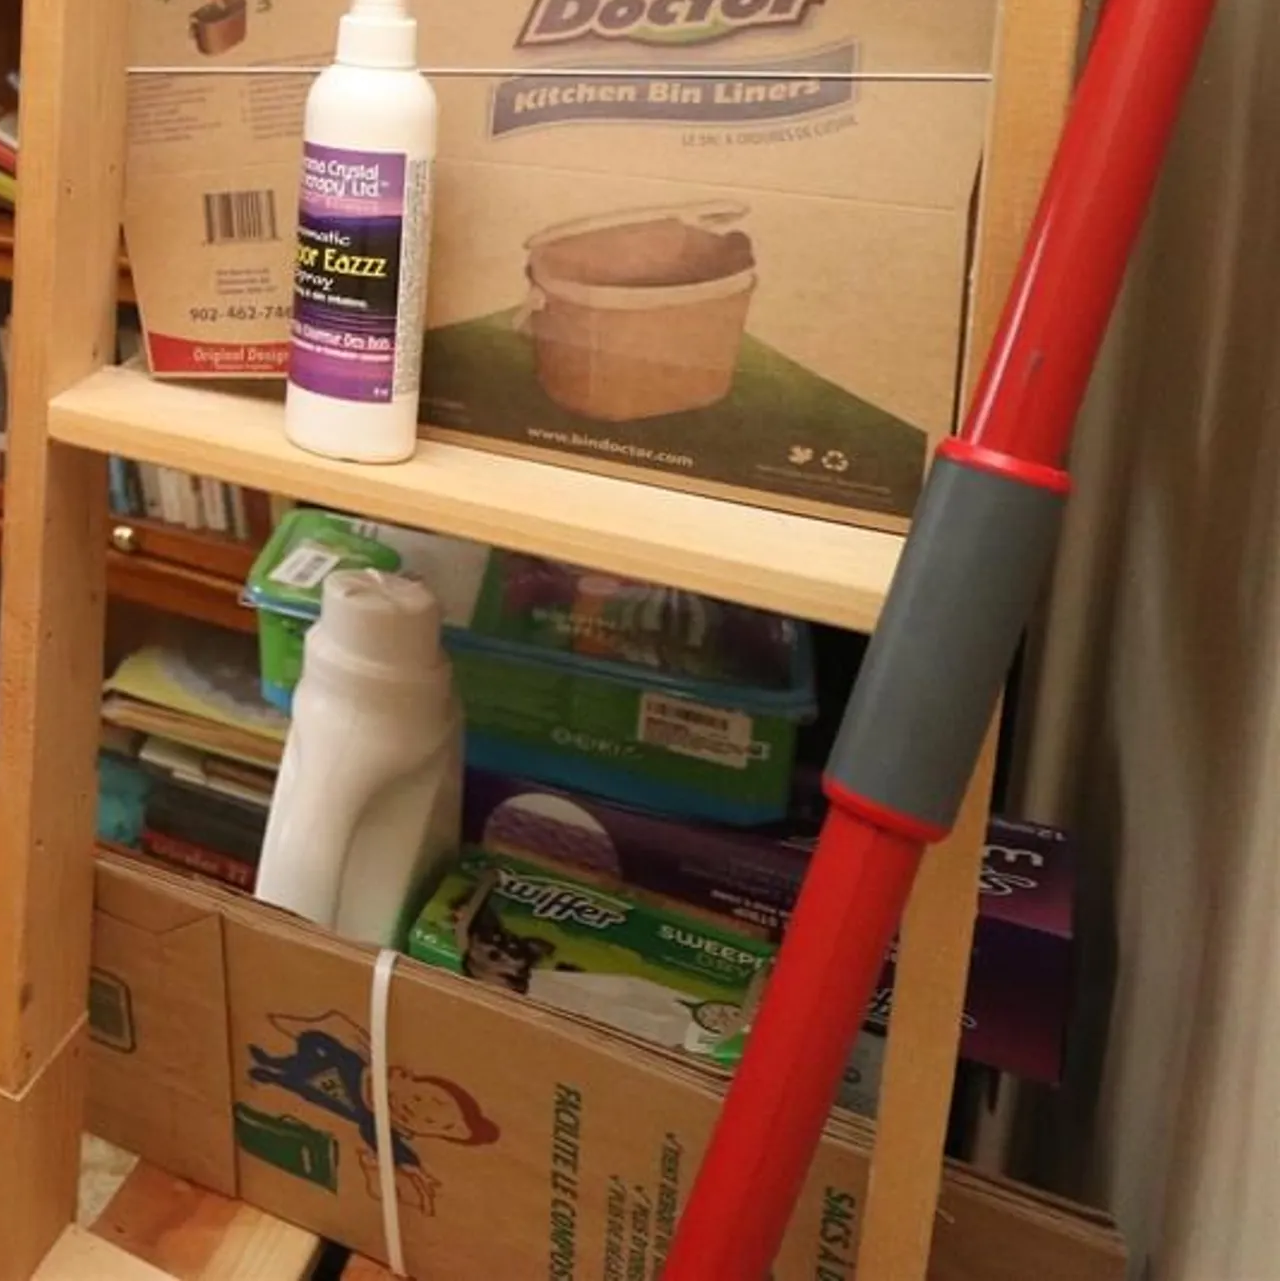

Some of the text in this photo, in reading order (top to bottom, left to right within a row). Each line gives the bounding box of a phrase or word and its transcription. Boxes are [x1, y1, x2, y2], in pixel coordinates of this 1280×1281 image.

[513, 79, 821, 115] Kitchen Bin Liners
[328, 160, 379, 182] Crystal
[324, 248, 388, 277] Eazzz
[193, 346, 244, 367] Original
[526, 426, 695, 468] www.bindoctor.com
[819, 1185, 857, 1250] SACS
